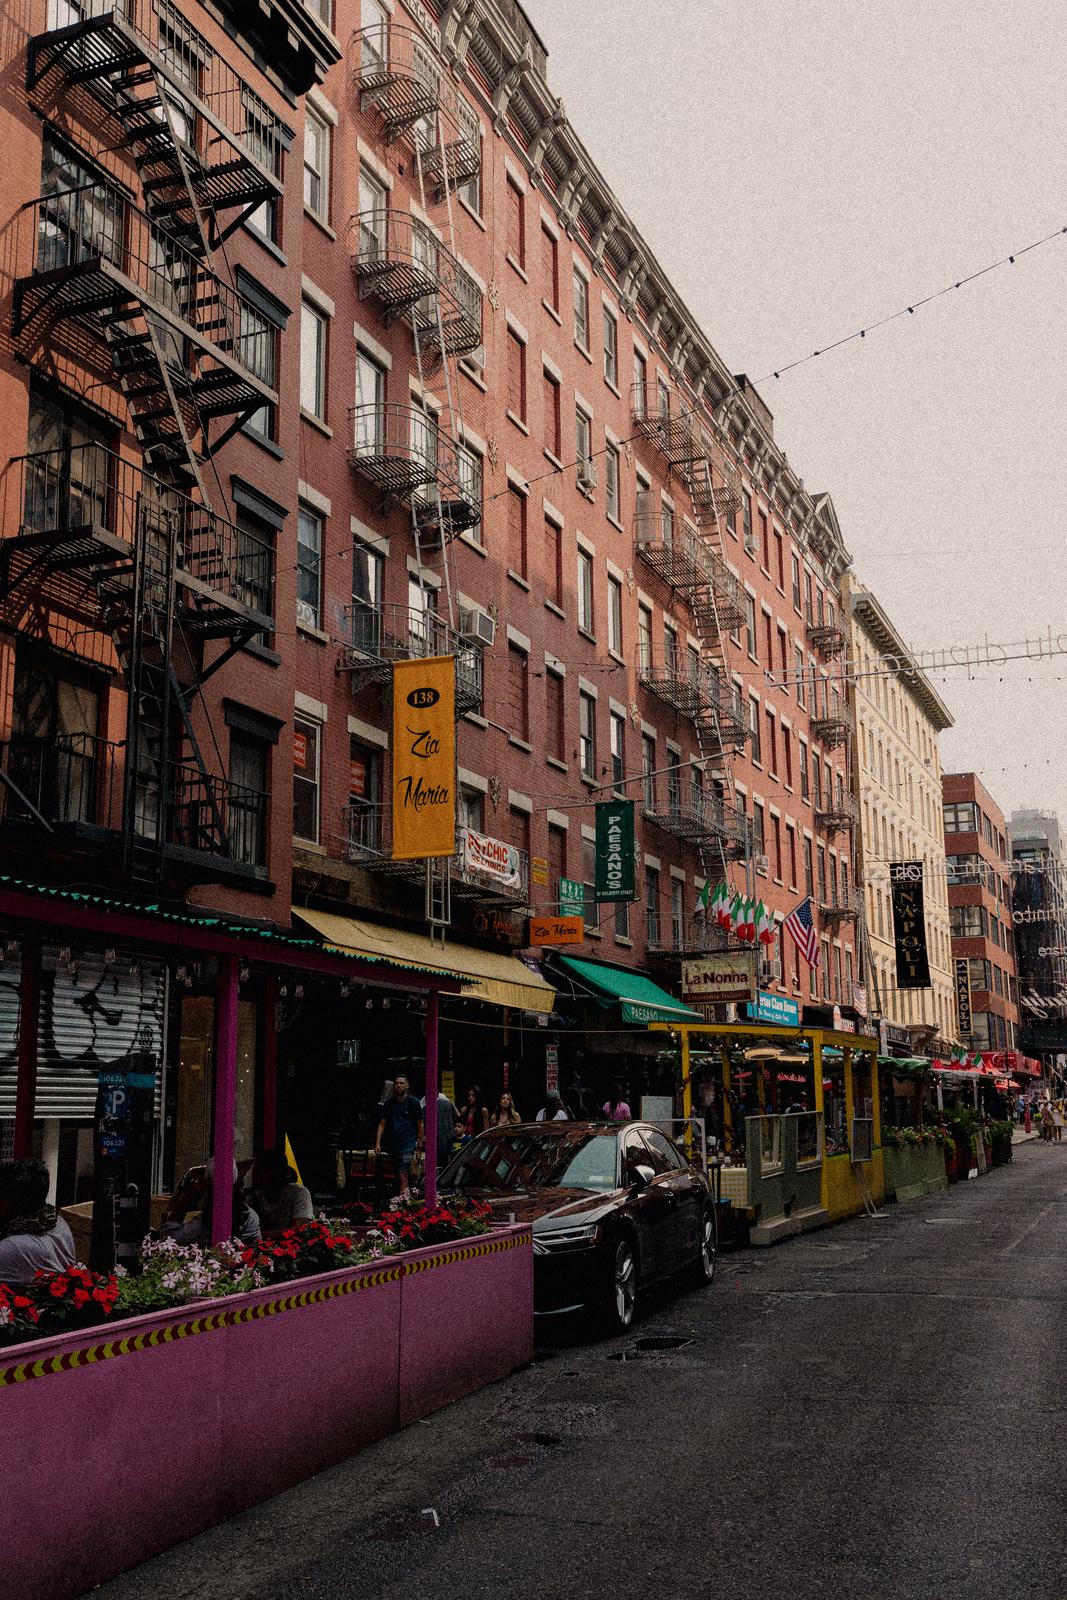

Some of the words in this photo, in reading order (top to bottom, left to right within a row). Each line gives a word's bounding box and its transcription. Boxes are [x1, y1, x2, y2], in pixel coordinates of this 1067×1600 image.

[412, 691, 434, 705] 138
[406, 724, 440, 758] Zia
[396, 775, 449, 813] Maria
[899, 891, 920, 977] NAPOLI
[685, 972, 700, 985] La
[703, 972, 748, 984] Nonna
[111, 1090, 126, 1114] P
